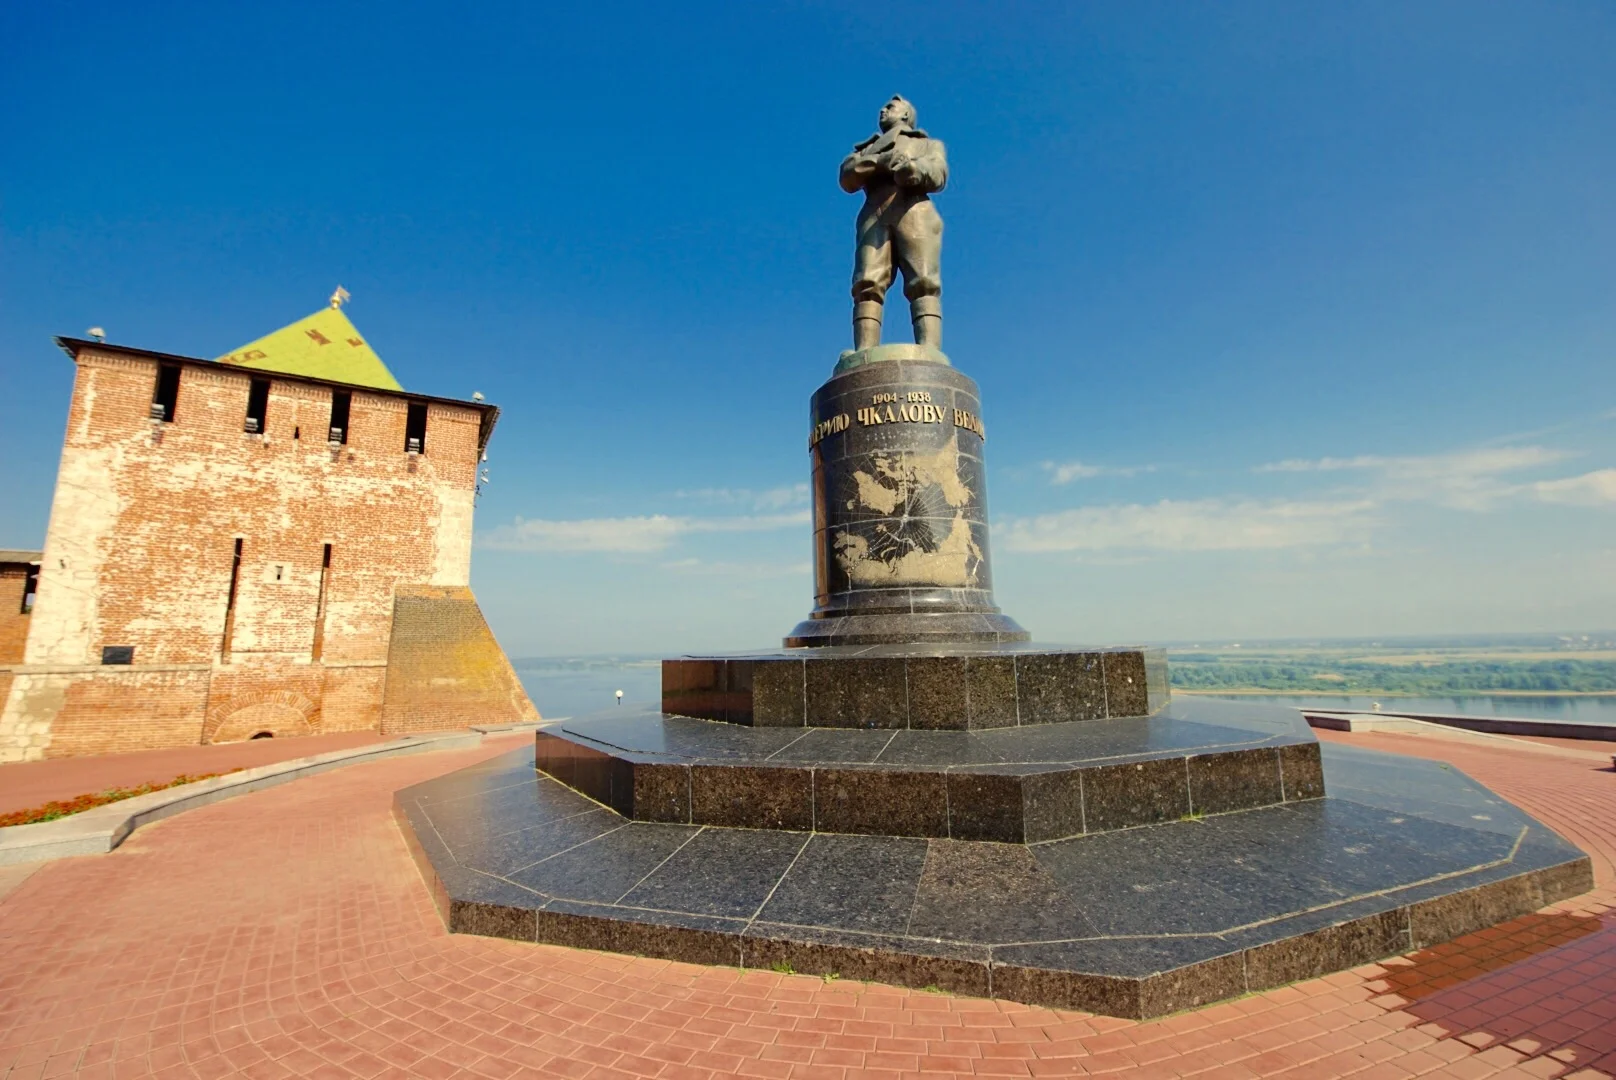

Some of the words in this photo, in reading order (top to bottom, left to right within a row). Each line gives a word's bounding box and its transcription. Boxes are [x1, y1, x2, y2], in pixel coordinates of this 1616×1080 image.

[873, 392, 897, 404] 1904
[907, 391, 931, 402] 1938
[857, 404, 946, 425] ЧКАЛОВУ
